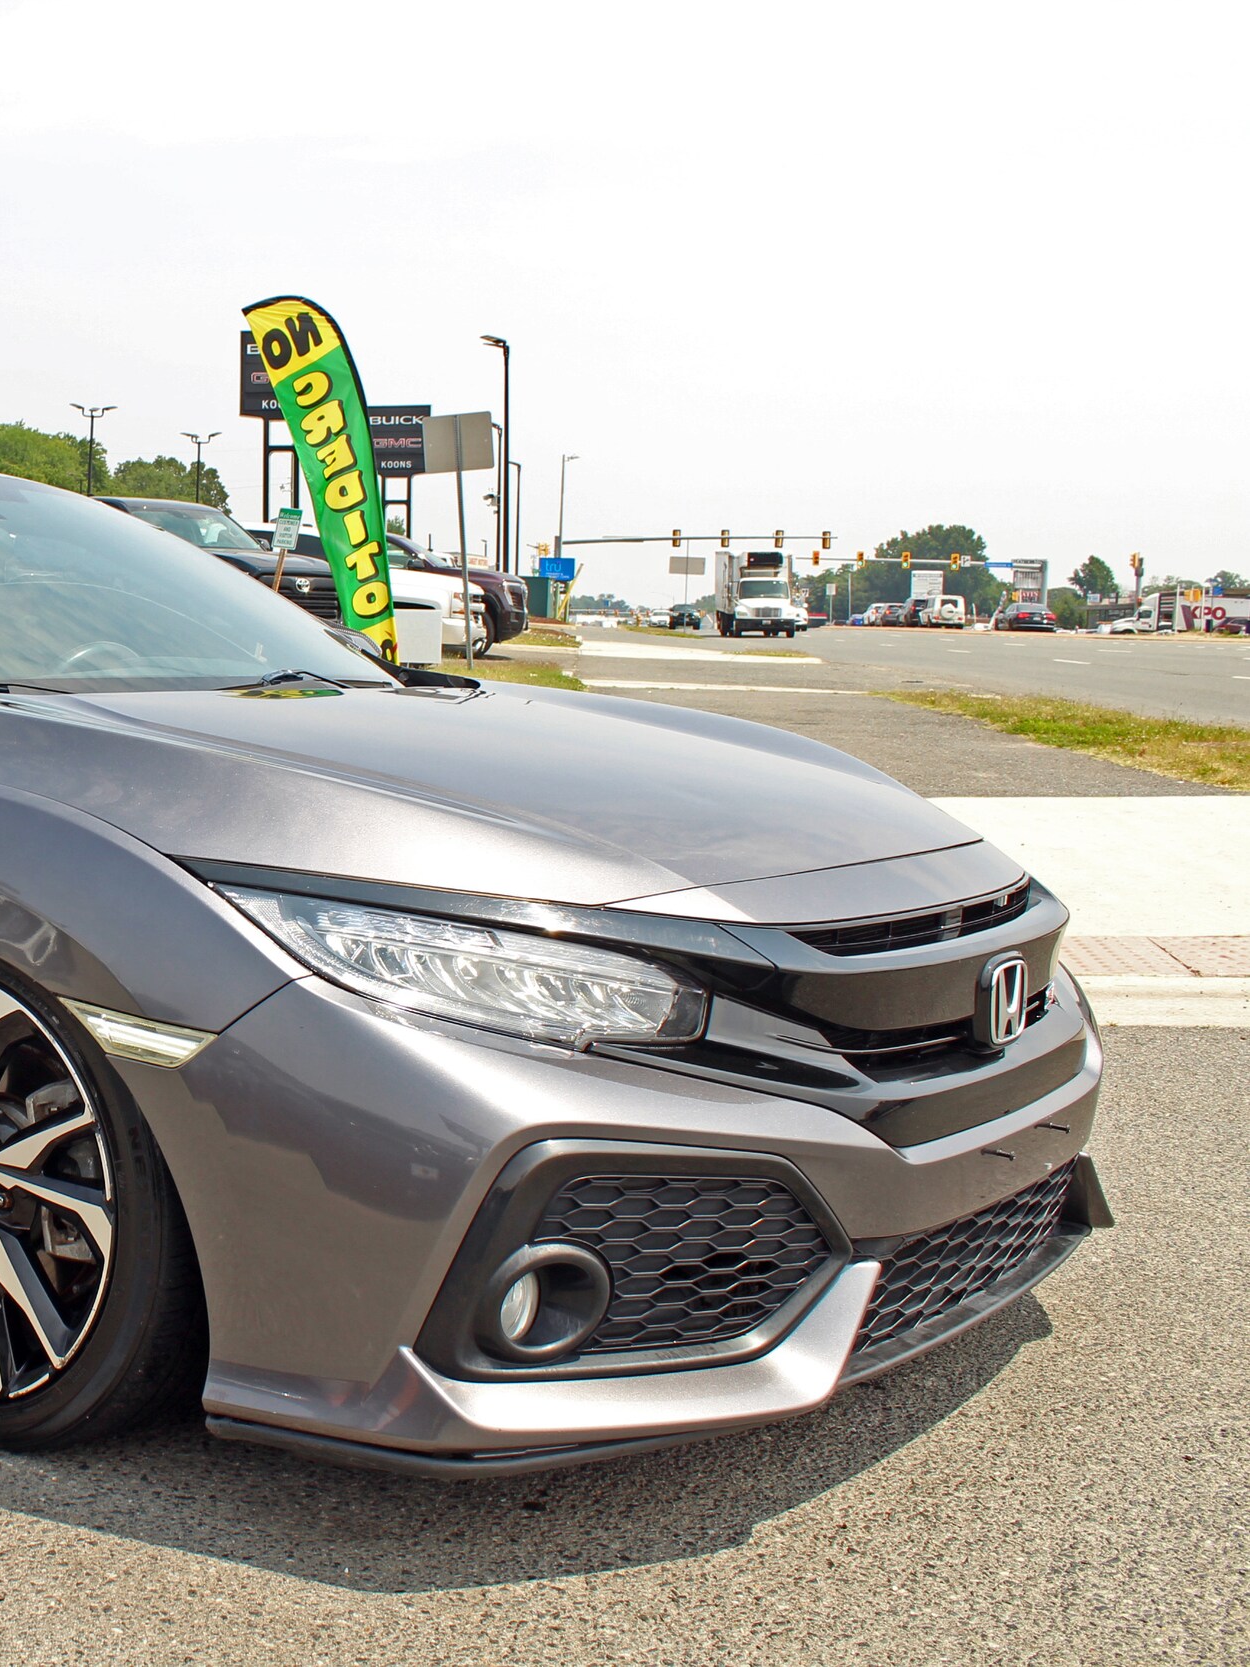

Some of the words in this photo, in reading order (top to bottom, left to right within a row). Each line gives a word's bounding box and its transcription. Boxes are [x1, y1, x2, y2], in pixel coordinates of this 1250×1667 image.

[369, 415, 424, 425] BUICK
[372, 437, 422, 448] GMC
[381, 460, 412, 469] KOONS
